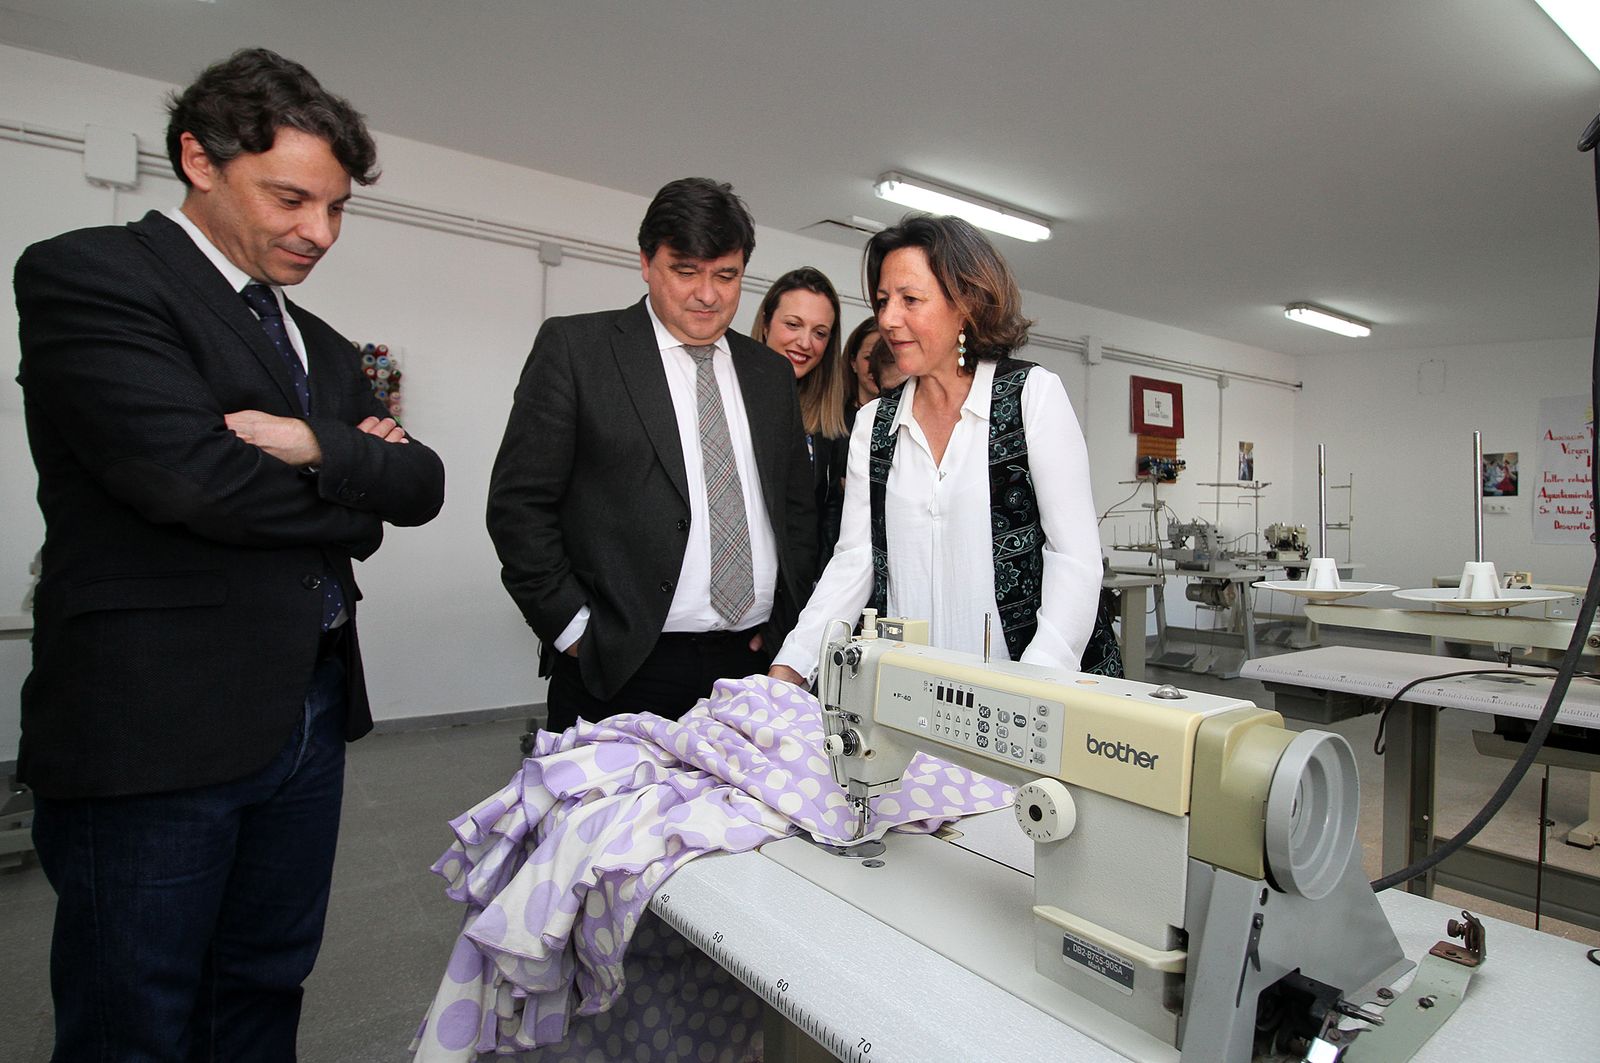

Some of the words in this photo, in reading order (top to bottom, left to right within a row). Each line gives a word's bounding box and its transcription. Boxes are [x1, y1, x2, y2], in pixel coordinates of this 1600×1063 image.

[1561, 442, 1589, 459] Virgen
[1086, 733, 1159, 770] brother
[660, 893, 670, 903] 40
[712, 931, 724, 943] 50
[1088, 960, 1100, 971] Mark
[776, 978, 789, 992] 60
[857, 1037, 872, 1054] 70
